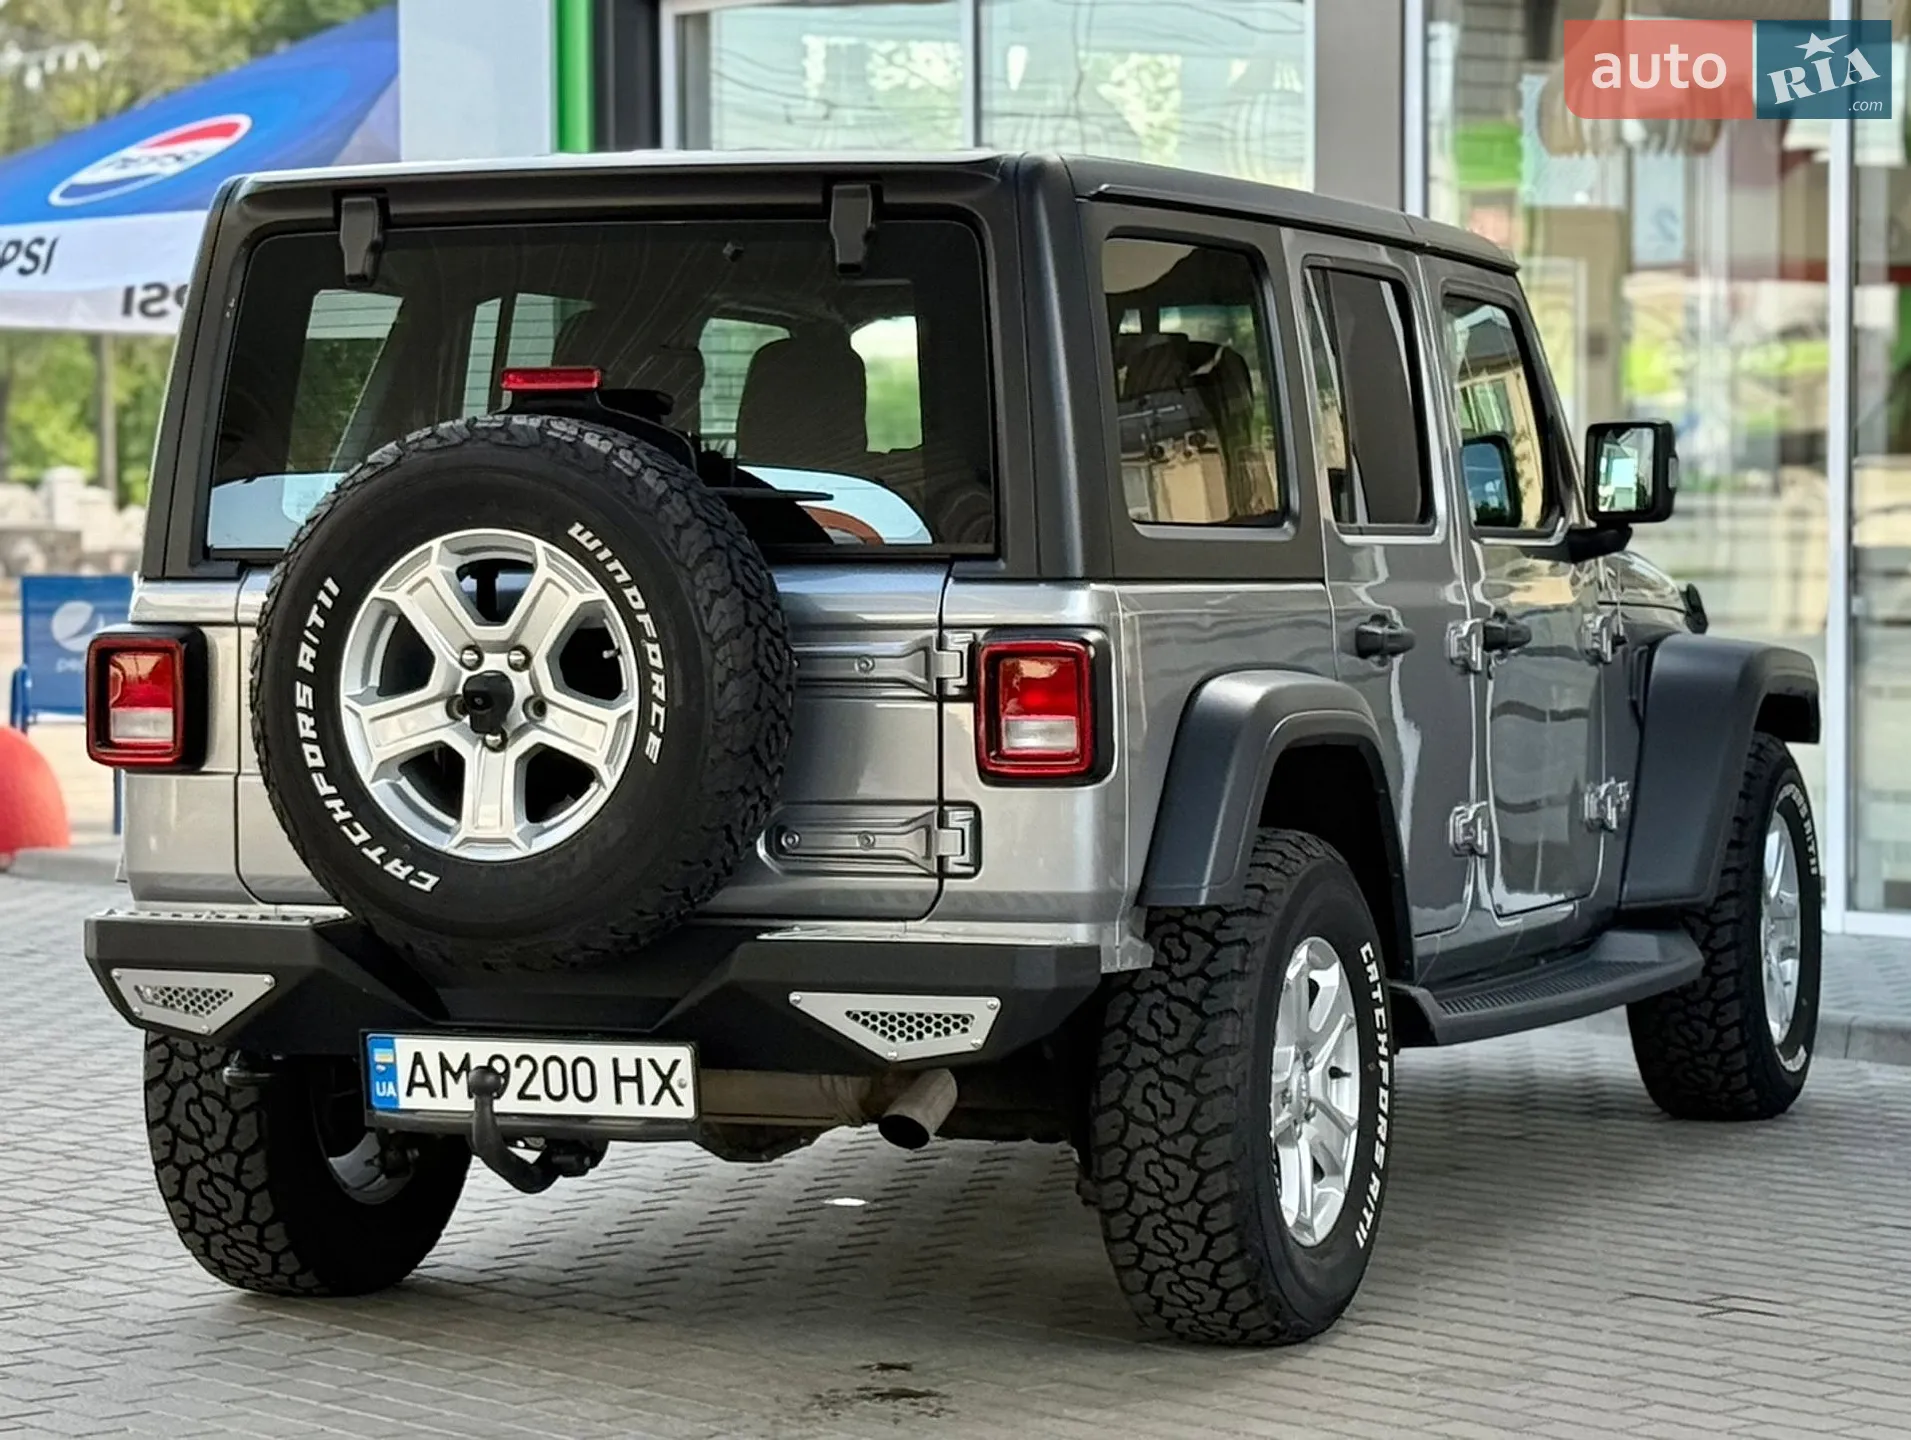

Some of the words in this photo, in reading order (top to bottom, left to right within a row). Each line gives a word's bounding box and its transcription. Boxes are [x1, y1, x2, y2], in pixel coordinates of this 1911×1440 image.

[566, 521, 669, 765] WINDFORCE
[295, 680, 442, 893] CATCHFORS
[375, 1080, 397, 1098] UA
[405, 1051, 474, 1100] AM
[487, 1053, 598, 1103] 9200
[612, 1057, 685, 1107] HX
